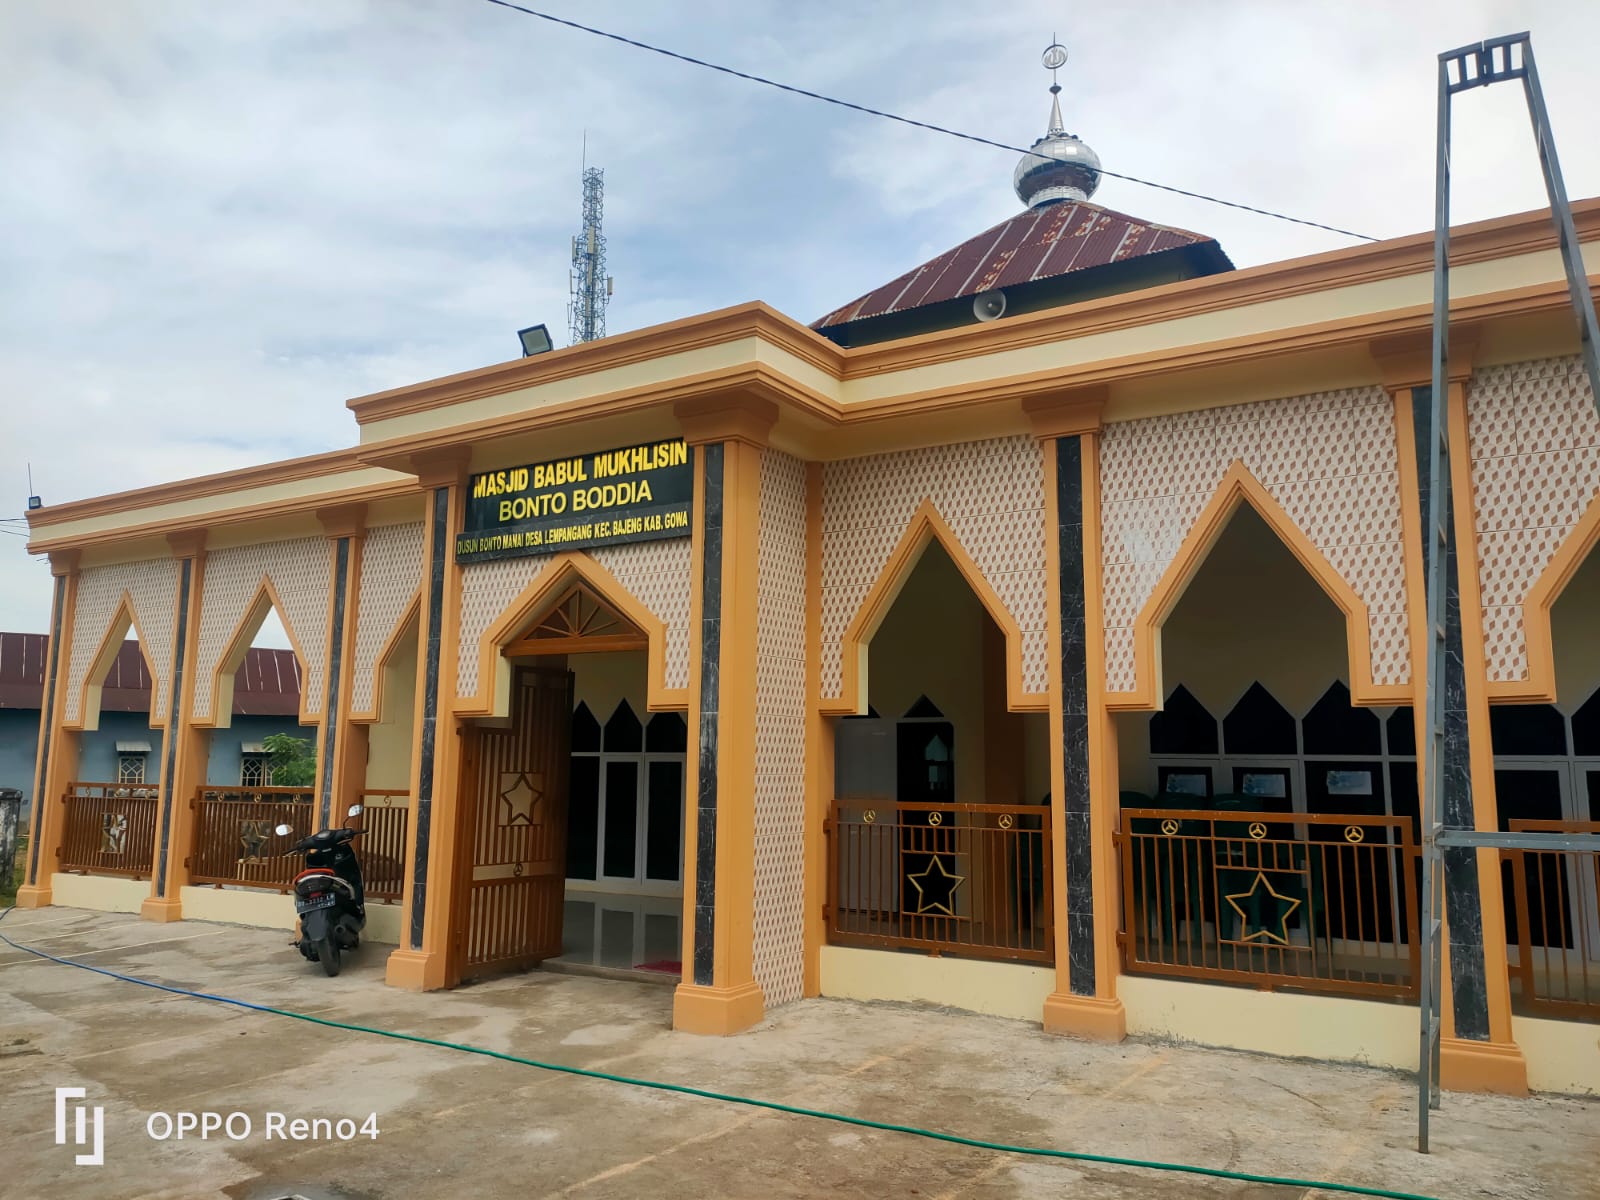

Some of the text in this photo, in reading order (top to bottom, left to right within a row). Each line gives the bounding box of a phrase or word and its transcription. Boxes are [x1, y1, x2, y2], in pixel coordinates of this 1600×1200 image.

[473, 440, 688, 499] MASJID BABUL MUKHLISIN
[499, 479, 653, 522] BONTO BODDIA
[457, 536, 479, 555] DUSUN
[479, 534, 502, 552] BONTO
[525, 530, 543, 547] DESA
[544, 524, 593, 545] LEMPANGANG
[594, 520, 612, 538] KEC.
[612, 516, 642, 536] BAJENG
[643, 513, 664, 532] KAB.
[664, 510, 689, 529] GOWA
